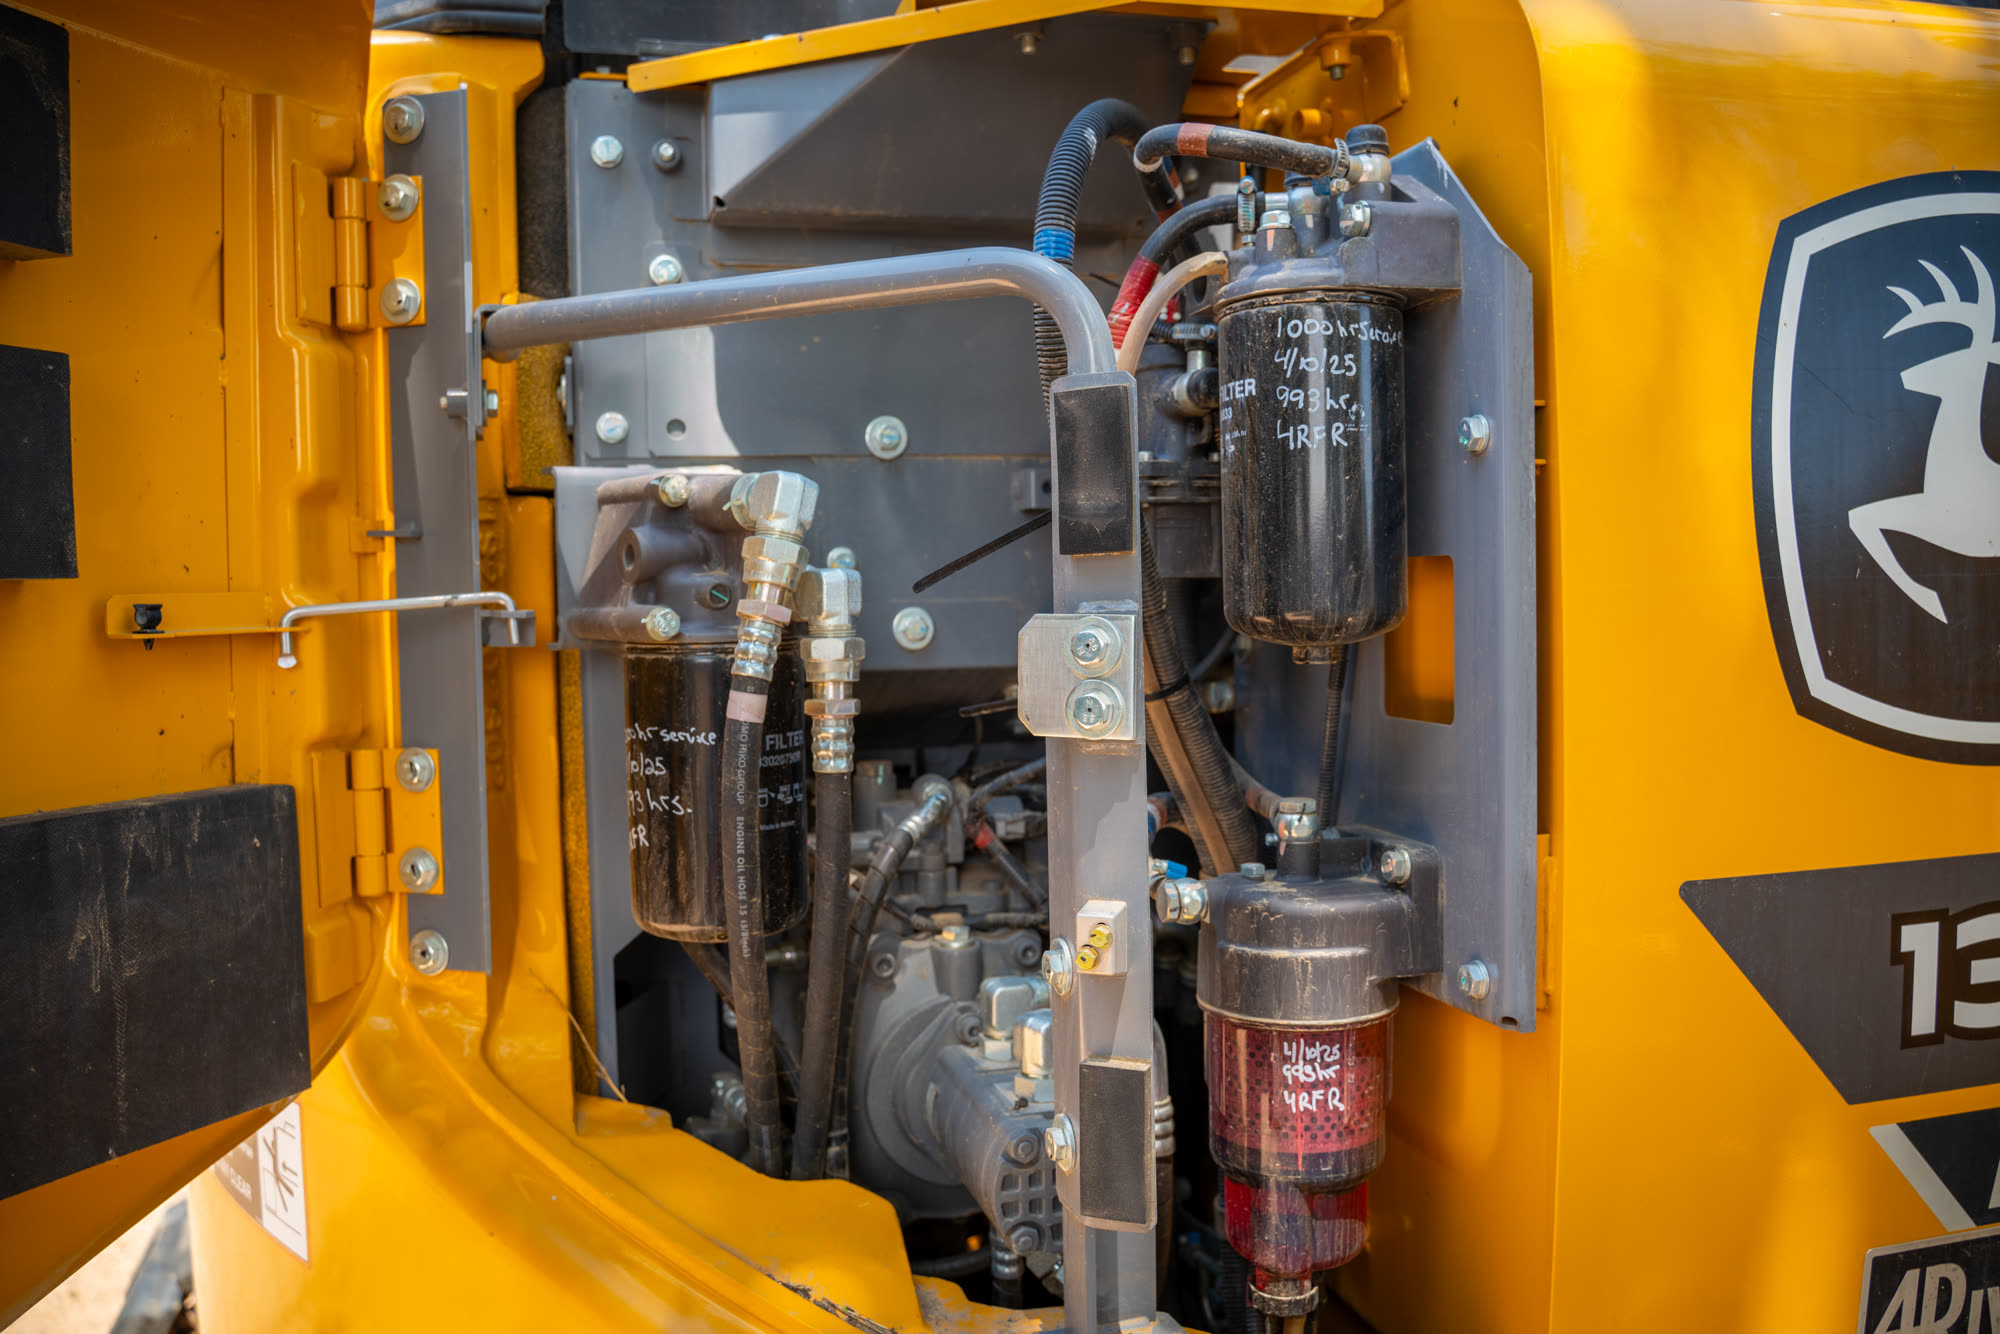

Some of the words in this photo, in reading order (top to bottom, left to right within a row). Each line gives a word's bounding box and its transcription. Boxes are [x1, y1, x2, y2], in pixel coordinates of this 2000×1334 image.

[1276, 316, 1333, 338] 1000
[1274, 347, 1356, 378] 4/10/25
[1276, 386, 1320, 413] 993
[1277, 419, 1349, 451] 4RFR
[659, 728, 717, 746] service
[736, 769, 746, 805] GROUP
[736, 816, 745, 855] ENGINE
[736, 856, 746, 873] OIL
[737, 875, 747, 901] HOSE
[739, 904, 748, 916] 15
[1283, 1038, 1341, 1064] 4/10/25
[1283, 1086, 1345, 1114] 4RFR
